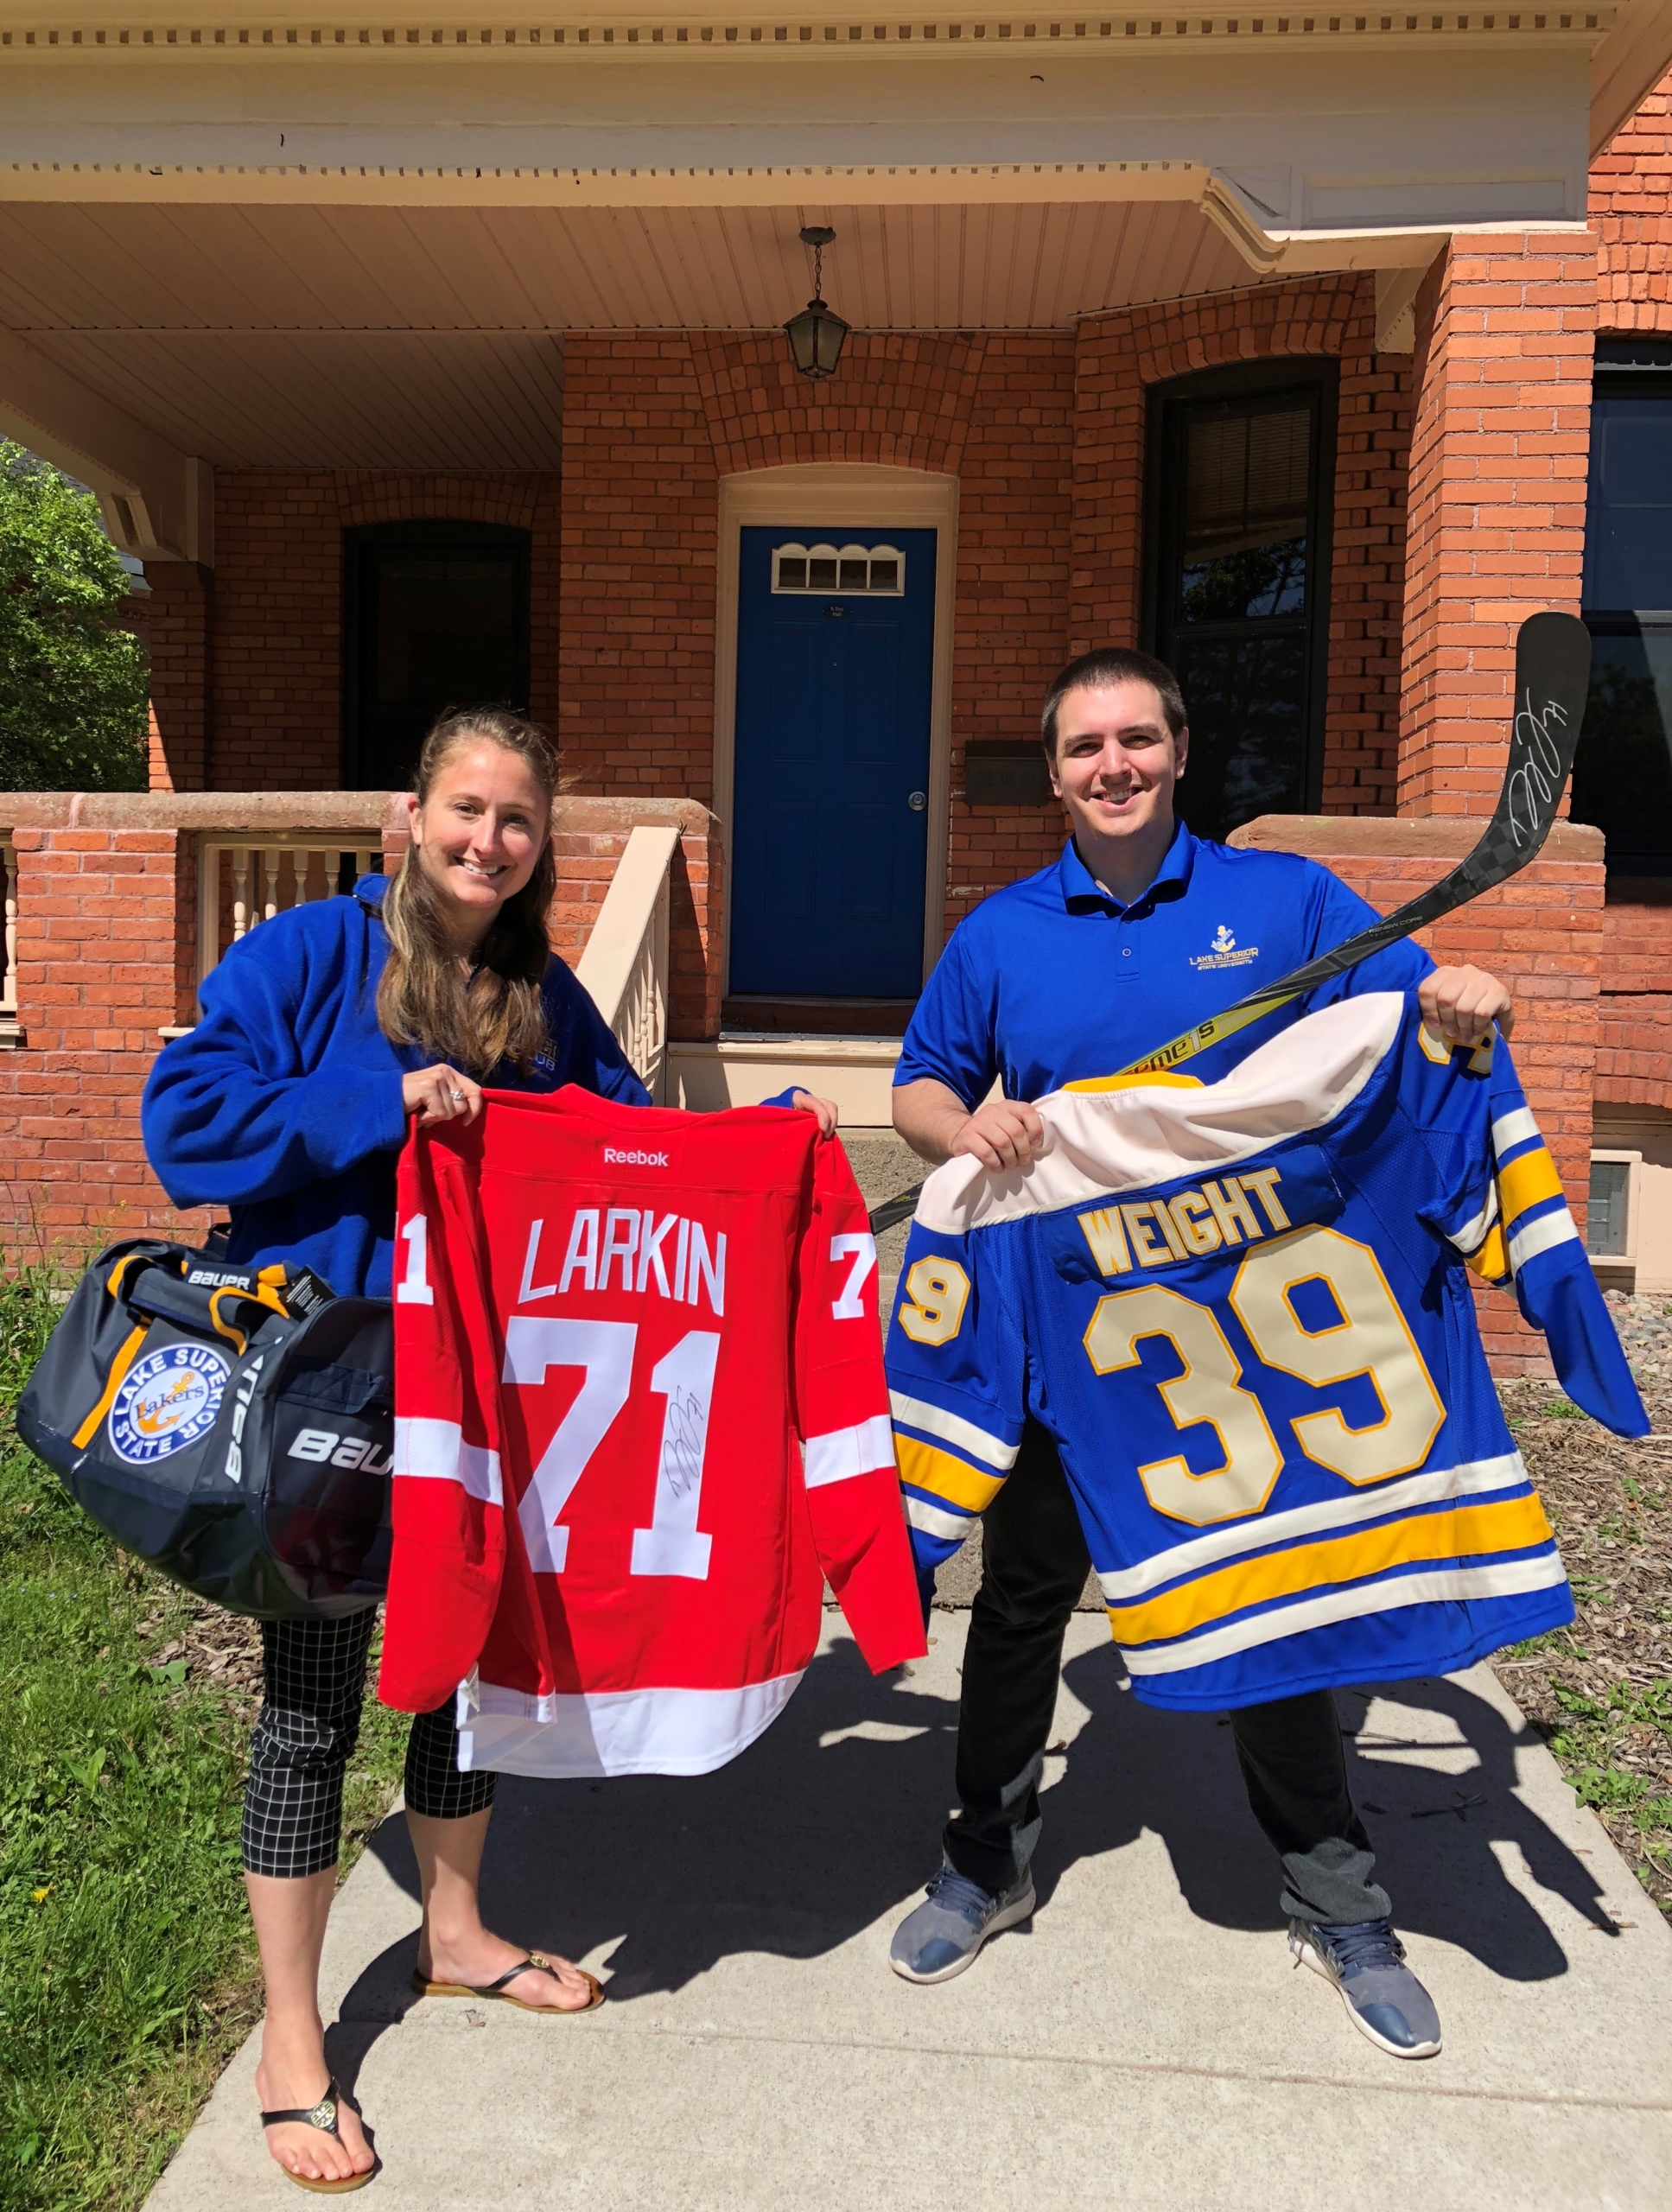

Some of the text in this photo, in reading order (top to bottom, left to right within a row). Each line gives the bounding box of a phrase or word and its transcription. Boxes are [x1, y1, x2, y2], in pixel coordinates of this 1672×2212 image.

[1189, 947, 1259, 965] LAKE SUPERIOR
[1217, 959, 1253, 969] UNIVERSITY
[604, 1147, 670, 1166] Reebok
[397, 1213, 434, 1306] 1
[518, 1208, 727, 1317] LARKIN
[1077, 1166, 1295, 1277] WEIGHT
[830, 1233, 878, 1319] 7
[898, 1255, 970, 1346] 9
[114, 1348, 226, 1440] LAKE SUPERIOR
[133, 1384, 205, 1421] Lakers
[1082, 1223, 1446, 1528] 39
[115, 1421, 173, 1458] STATE
[502, 1315, 722, 1580] 71
